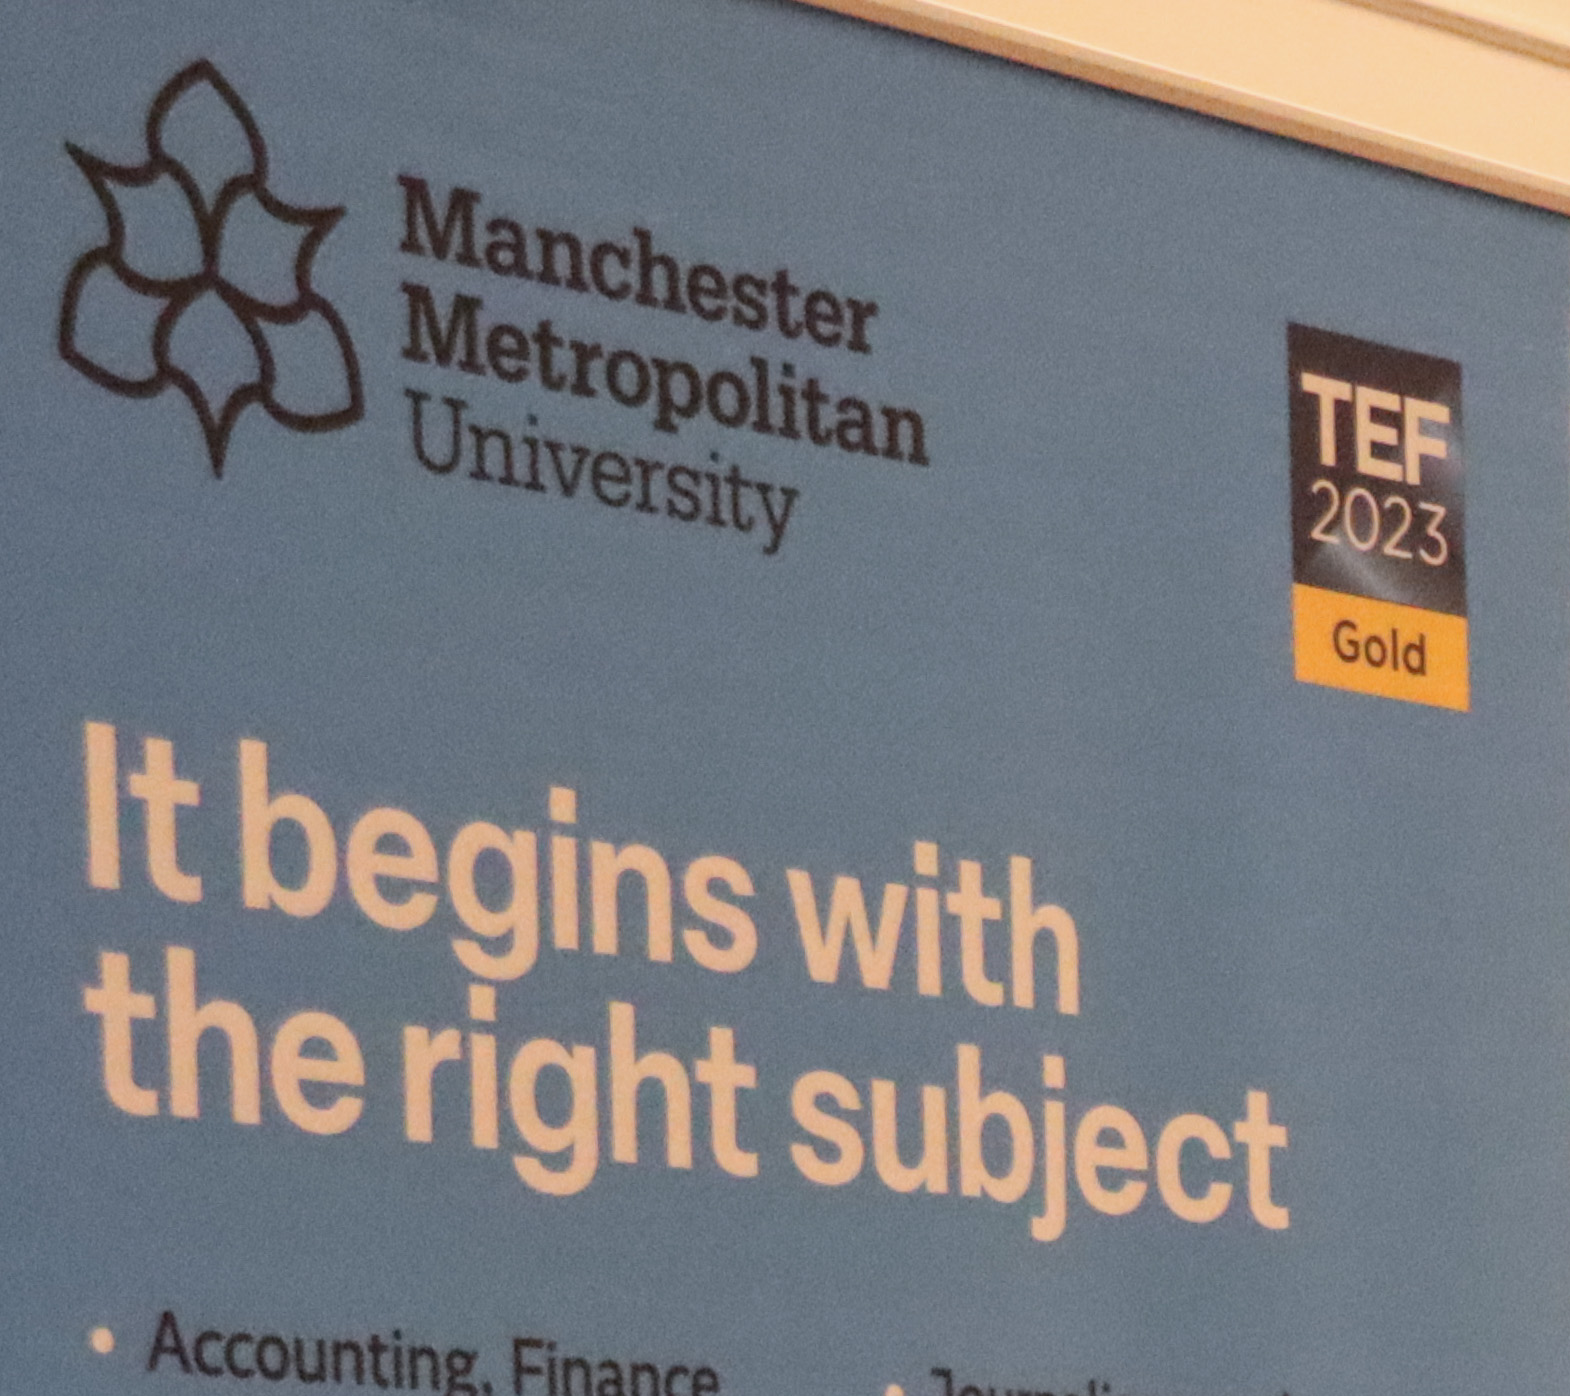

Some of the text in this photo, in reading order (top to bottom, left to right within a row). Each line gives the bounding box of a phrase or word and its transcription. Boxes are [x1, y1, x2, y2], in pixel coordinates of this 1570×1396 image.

[397, 174, 878, 354] Manchester
[401, 281, 928, 475] Metropolitan
[1302, 370, 1450, 486] TEF
[404, 387, 799, 555] University
[1309, 479, 1447, 566] 2023
[1333, 619, 1426, 676] Gold
[85, 721, 1079, 1015] It begins with
[84, 946, 1289, 1242] the right subject
